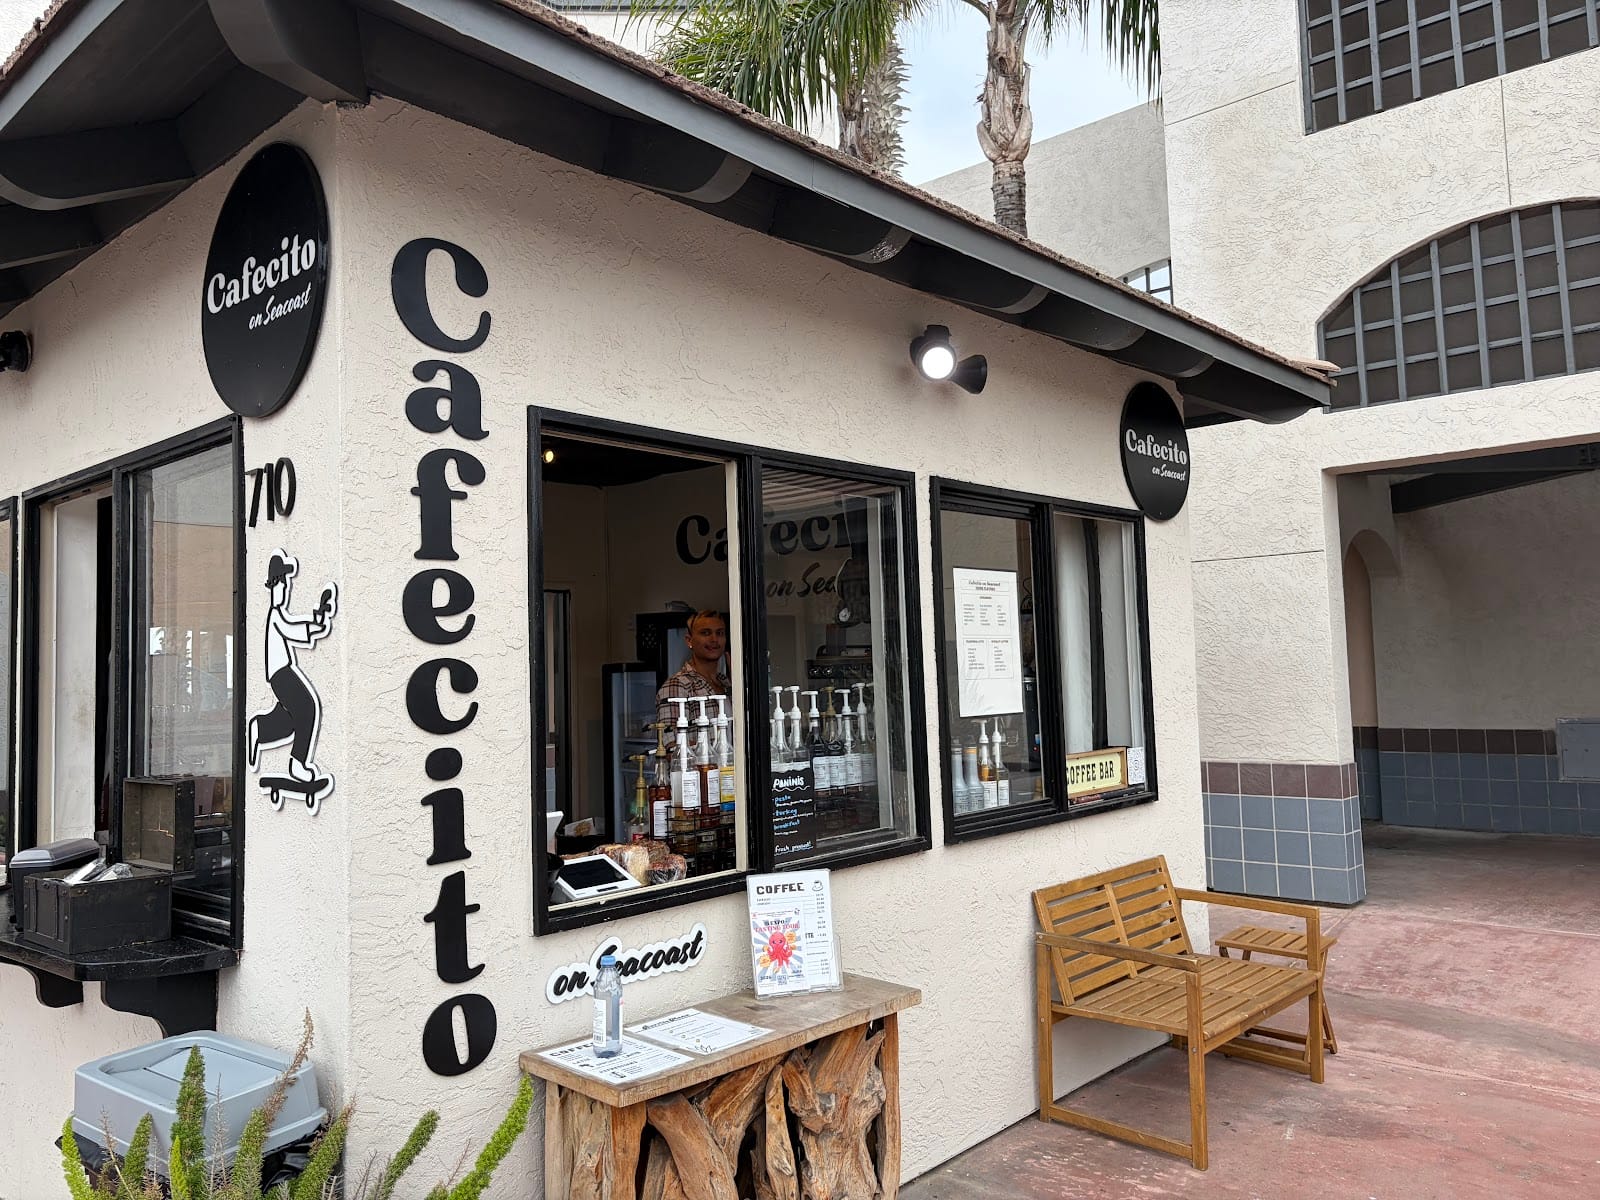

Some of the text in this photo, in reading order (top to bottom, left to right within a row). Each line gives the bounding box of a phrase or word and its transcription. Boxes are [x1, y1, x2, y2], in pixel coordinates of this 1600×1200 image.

[207, 234, 316, 314] Cafecito
[249, 281, 312, 330] on Seacoast
[1125, 428, 1188, 465] Cafecito
[1151, 463, 1187, 481] on Seacoast
[244, 456, 297, 528] 710
[391, 238, 497, 1076] Cafecito
[1100, 760, 1115, 780] BAR
[756, 882, 805, 895] COFFEE
[553, 971, 589, 996] on
